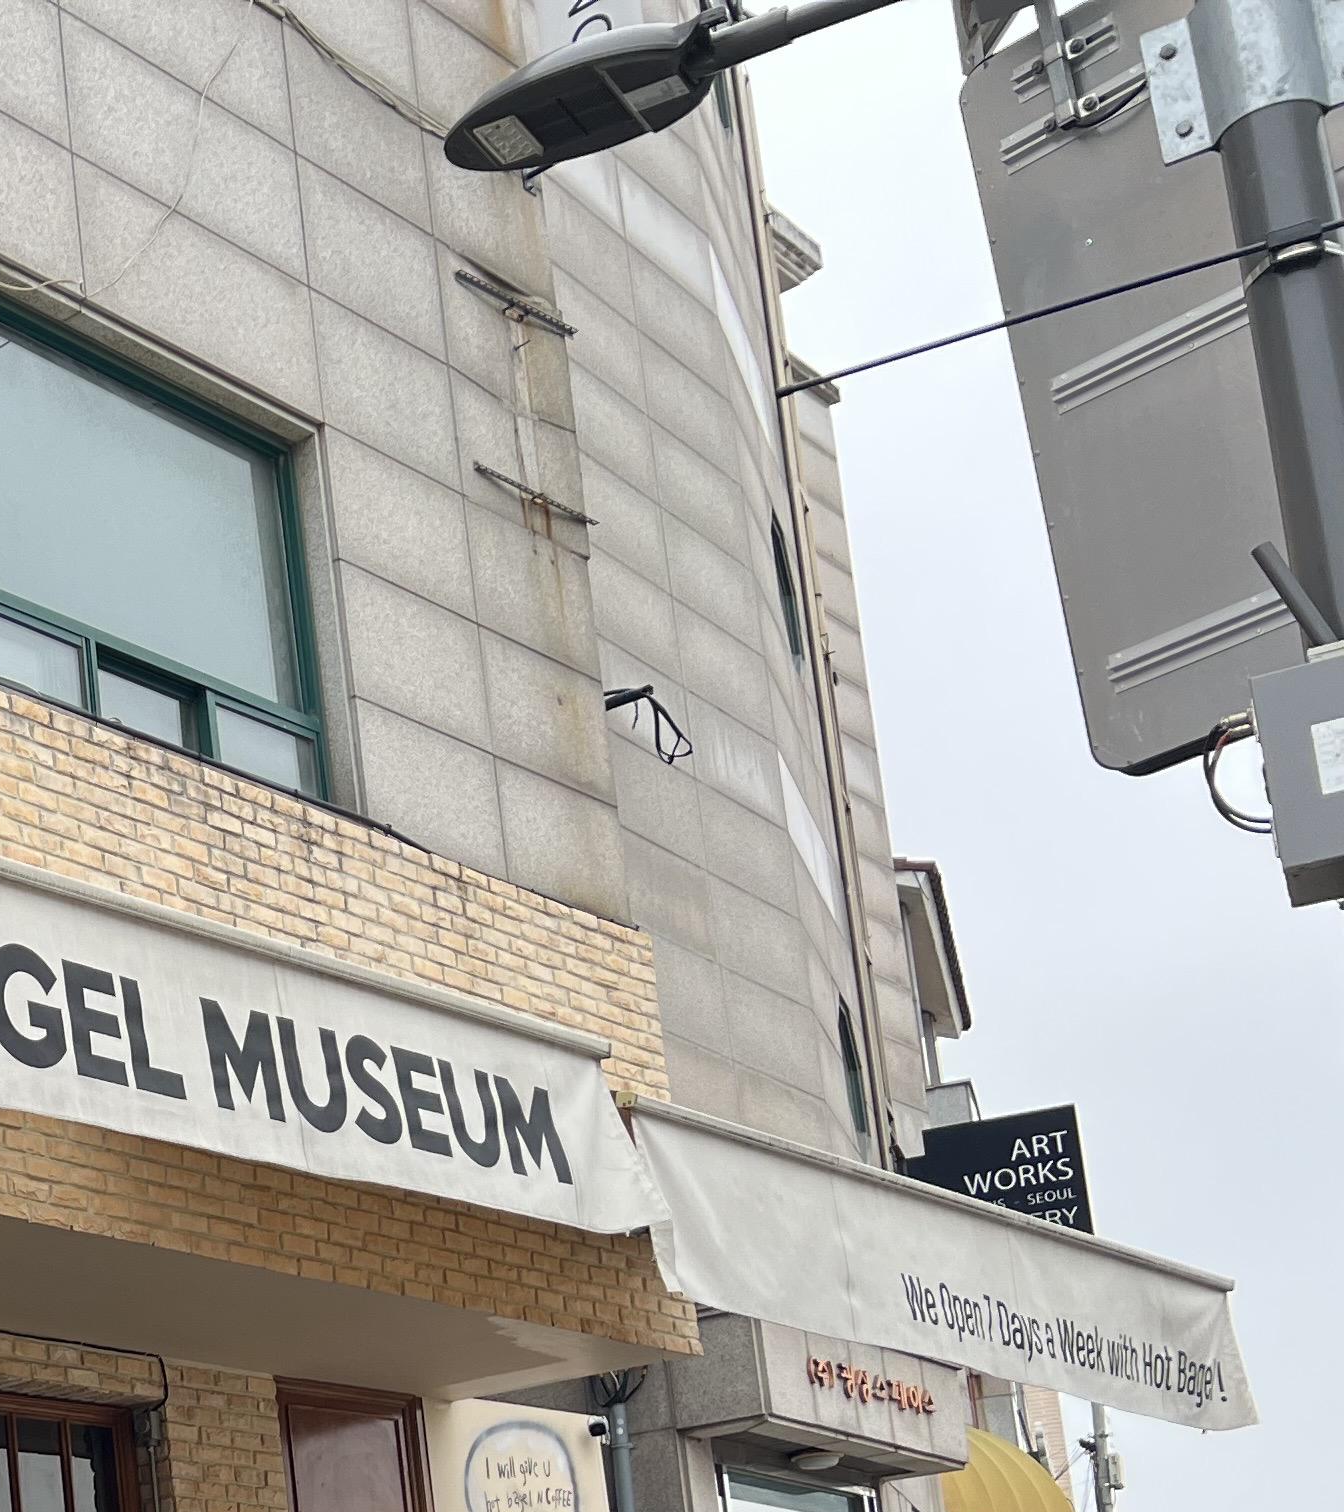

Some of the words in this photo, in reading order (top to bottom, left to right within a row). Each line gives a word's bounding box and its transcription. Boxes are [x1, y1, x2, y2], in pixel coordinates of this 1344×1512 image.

[198, 996, 575, 1186] MUSEUM
[1010, 1129, 1068, 1162] ART
[963, 1157, 1074, 1196] WORKS
[1026, 1187, 1077, 1206] SEOUL
[900, 1272, 939, 1326] We
[939, 1281, 986, 1343] Open
[982, 1292, 994, 1342] 7
[996, 1299, 1044, 1363] Days
[1044, 1322, 1057, 1360] a
[1055, 1316, 1106, 1374] Week
[1107, 1332, 1141, 1383] with
[1142, 1341, 1173, 1392] Hot
[485, 1456, 491, 1480] I
[497, 1456, 516, 1480] will
[519, 1456, 539, 1487] give
